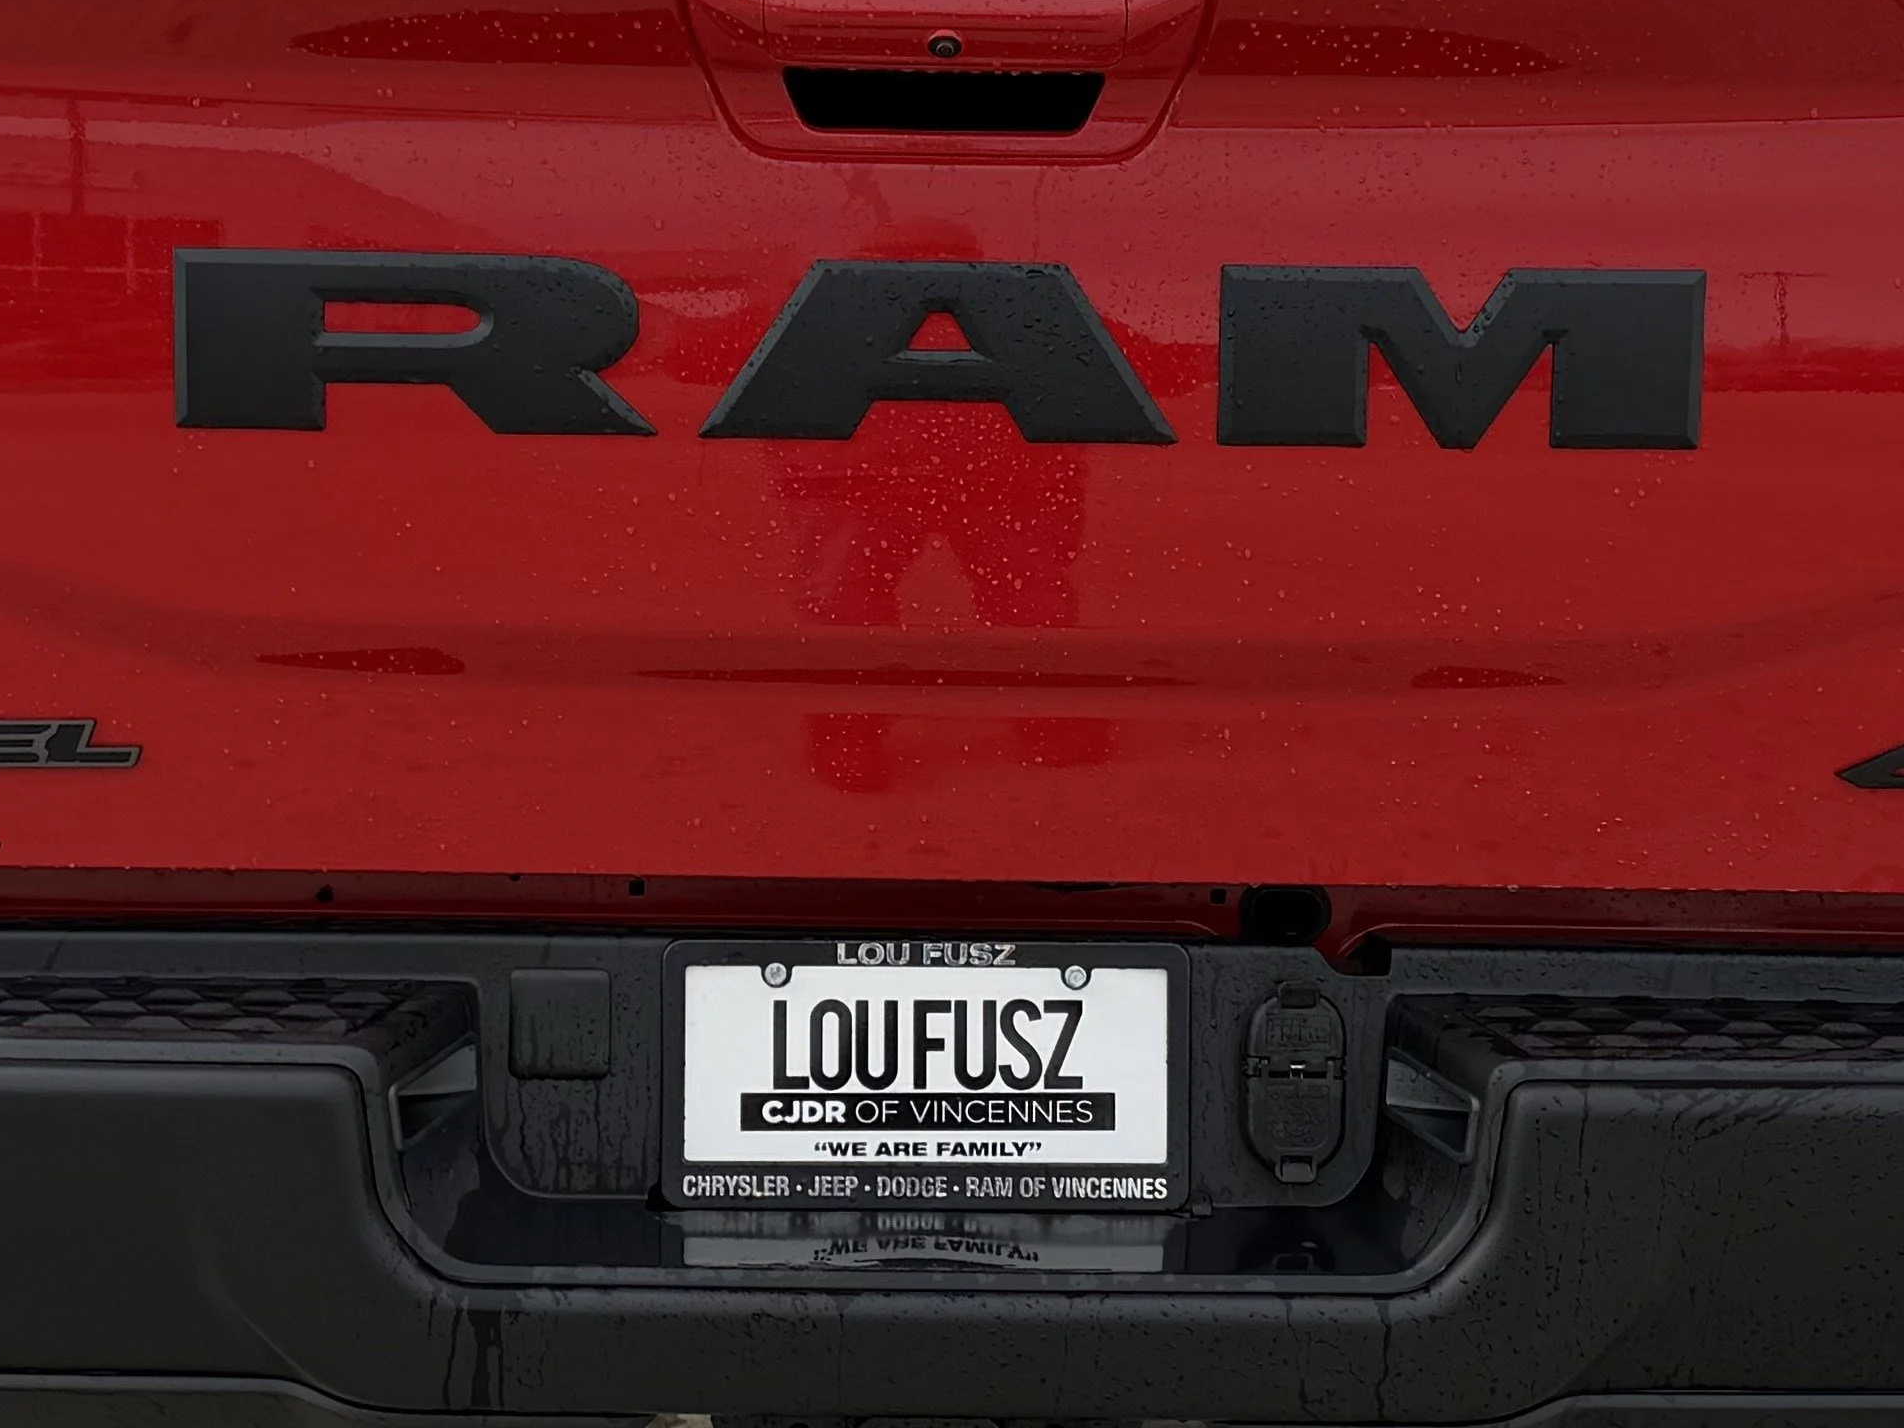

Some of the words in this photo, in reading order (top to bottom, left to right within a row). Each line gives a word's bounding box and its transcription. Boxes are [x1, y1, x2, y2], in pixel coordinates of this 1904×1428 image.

[173, 247, 1707, 450] RAM
[835, 941, 910, 967] LOU
[922, 942, 1017, 968] FUSZ
[761, 1100, 847, 1124] CJDR
[855, 1100, 900, 1124] OF
[909, 1100, 1093, 1124] VINCENNES
[874, 1142, 928, 1157] ARE
[682, 1175, 790, 1198] CHRYSLER
[807, 1175, 859, 1197] JEEP
[876, 1176, 948, 1198] DODGE
[965, 1176, 1013, 1198] RAM
[1019, 1176, 1046, 1198] OF
[1051, 1176, 1168, 1200] VINCENNES
